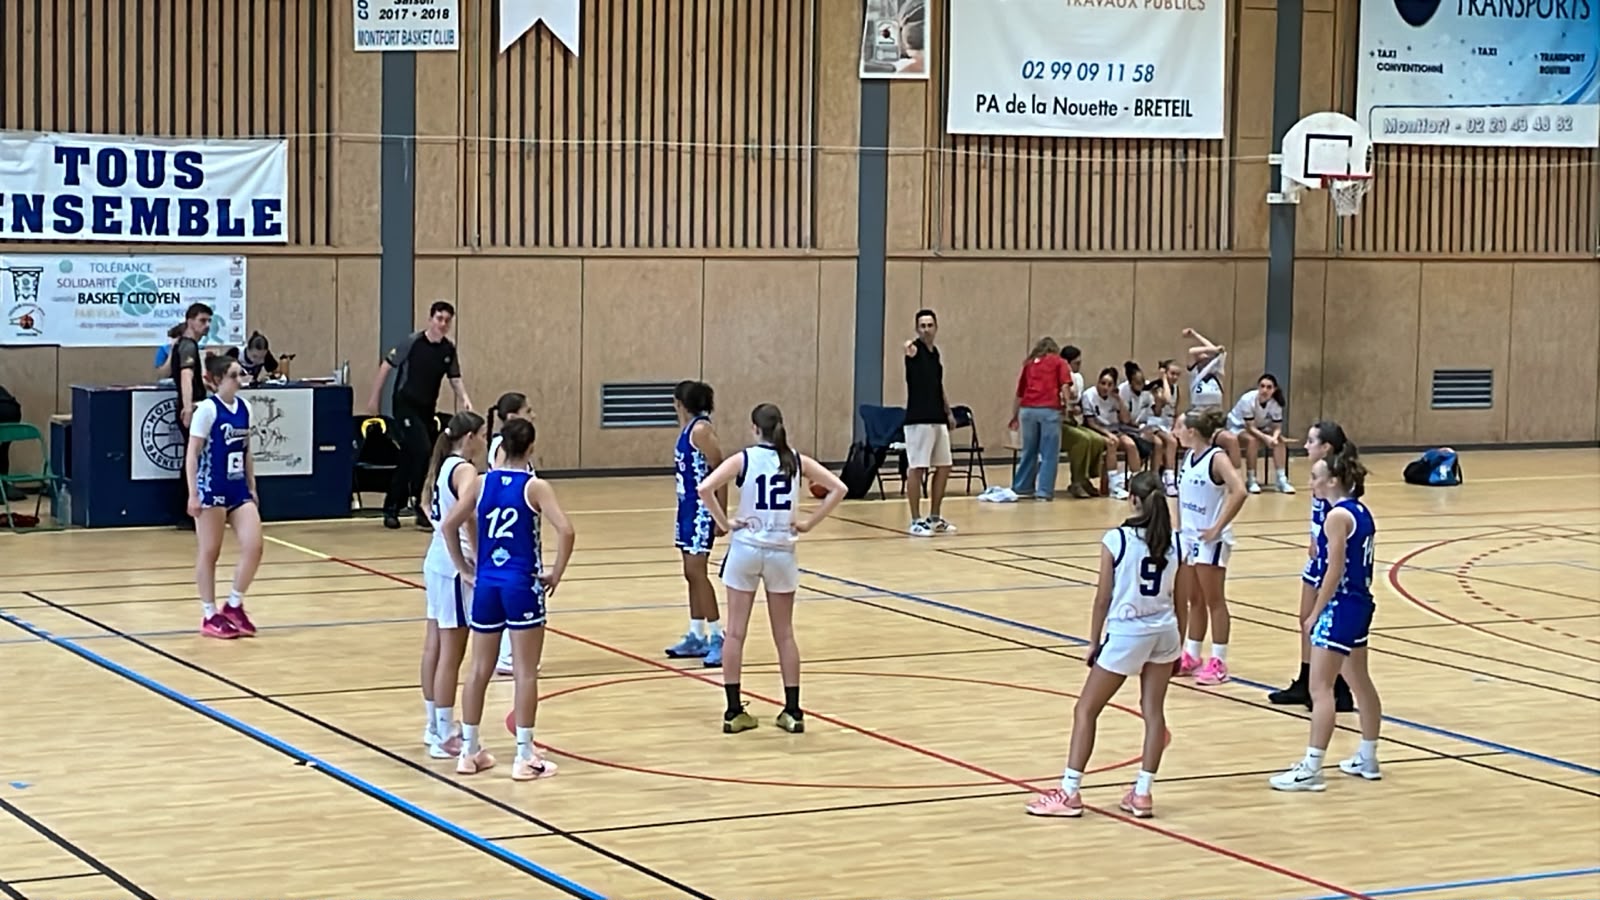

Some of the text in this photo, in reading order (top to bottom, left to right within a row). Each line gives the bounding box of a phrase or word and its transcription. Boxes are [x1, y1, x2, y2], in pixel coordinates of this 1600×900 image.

[1144, 0, 1206, 11] PUBLICS
[1457, 0, 1591, 20] TRANSPORTS
[379, 8, 450, 20] 2017 2018
[357, 29, 455, 46] MONTFORT BASKET CLUB
[1377, 49, 1397, 59] TAXI
[1478, 47, 1498, 56] TAXI
[1540, 52, 1586, 63] TRANSPORT
[1021, 60, 1156, 83] 02 99 09 11 58
[975, 93, 1000, 114] PA
[1005, 93, 1027, 114] de
[1031, 94, 1047, 115] la
[1053, 96, 1119, 117] Nouette
[1134, 98, 1194, 118] BRETEIL
[54, 145, 205, 190] TOUS
[90, 262, 153, 273] TOLÉRANCE
[56, 276, 218, 289] SOLIDARITÉ DIFFÉRENTS
[77, 292, 125, 305] BASKET
[127, 292, 181, 305] CITOYEN
[755, 474, 792, 511] 12
[485, 507, 519, 540] 12
[1139, 556, 1163, 597] 9
